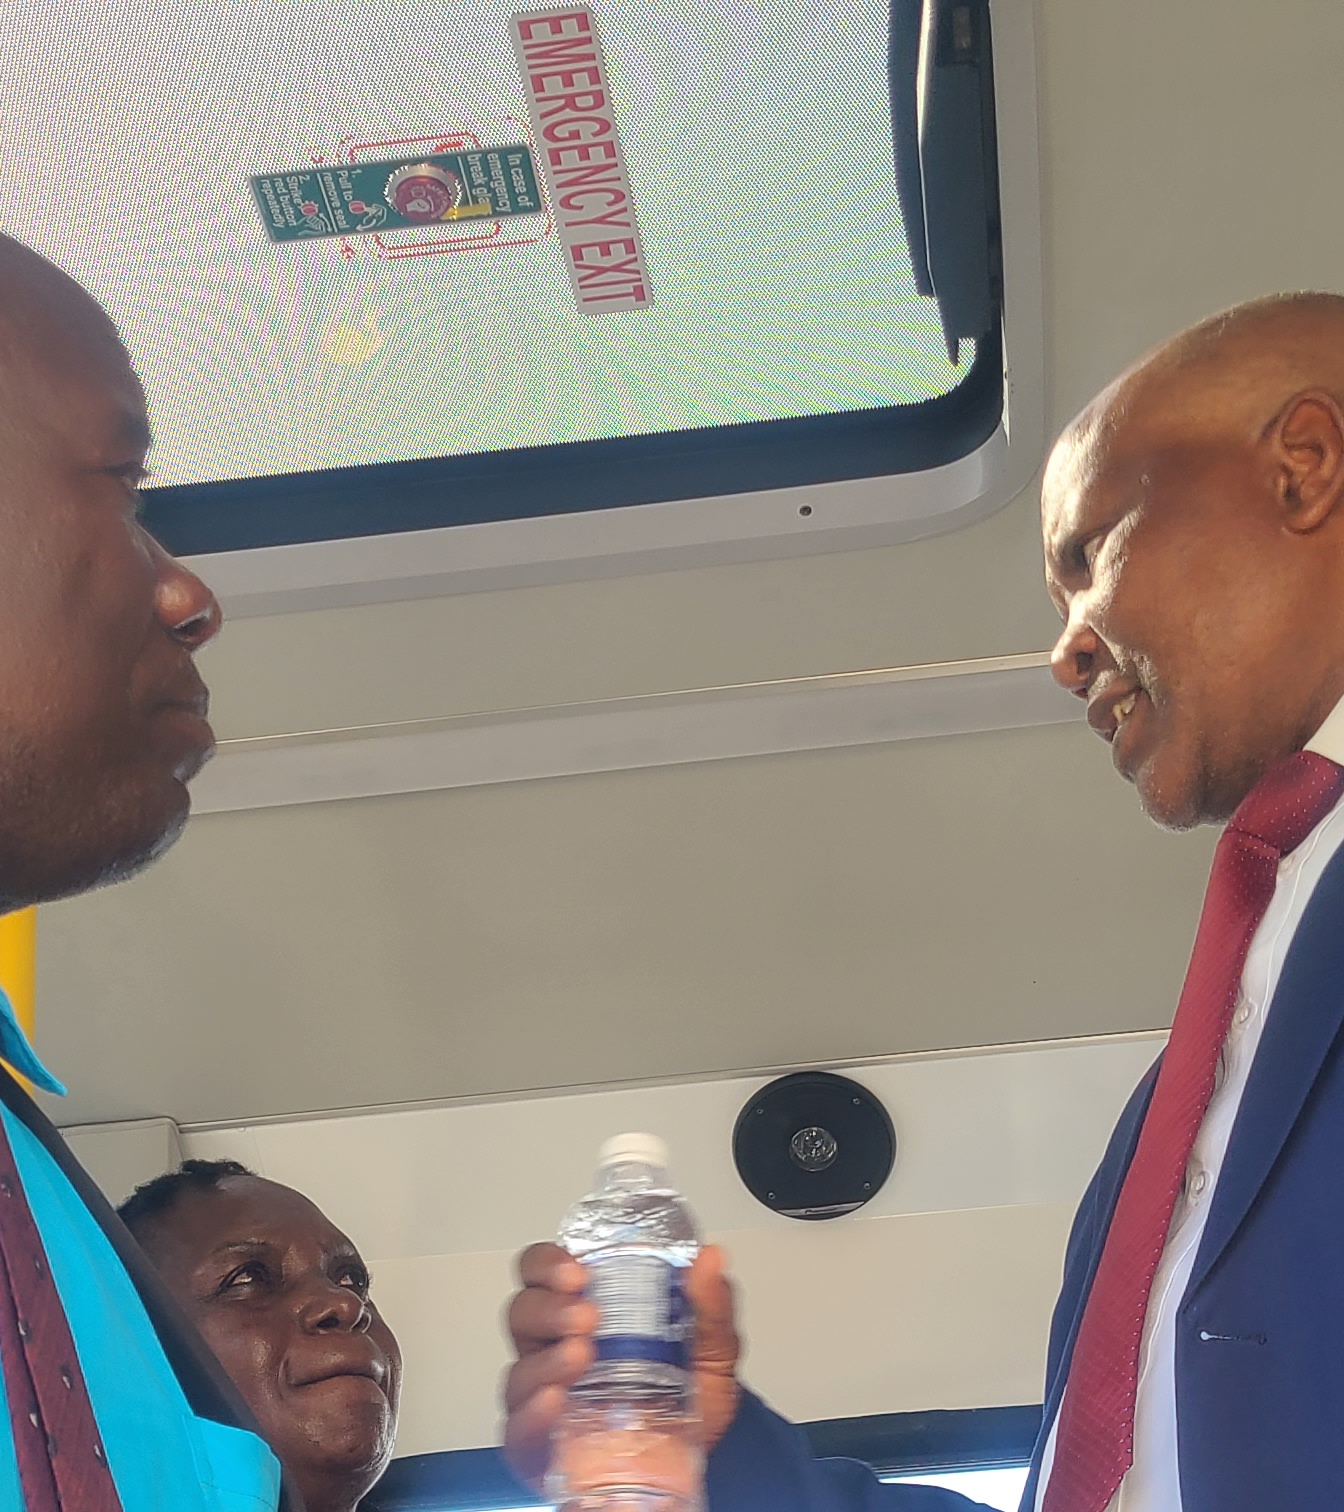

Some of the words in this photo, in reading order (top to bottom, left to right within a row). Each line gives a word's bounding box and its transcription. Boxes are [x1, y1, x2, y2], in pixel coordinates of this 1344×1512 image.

[517, 12, 631, 228] EMERGENCY
[351, 169, 362, 178] 1.
[467, 153, 488, 186] break
[507, 153, 522, 166] In
[273, 178, 288, 195] red
[286, 175, 302, 205] Strike
[298, 175, 310, 185] 2.
[336, 170, 353, 190] Pull
[487, 152, 512, 213] emergency
[511, 167, 527, 195] case
[260, 179, 286, 228] repeatedly
[323, 172, 341, 209] remove
[334, 208, 350, 229] seal
[342, 190, 353, 201] to
[472, 186, 492, 204] gla
[517, 195, 534, 208] of
[279, 195, 297, 227] button
[569, 237, 646, 303] EXIT
